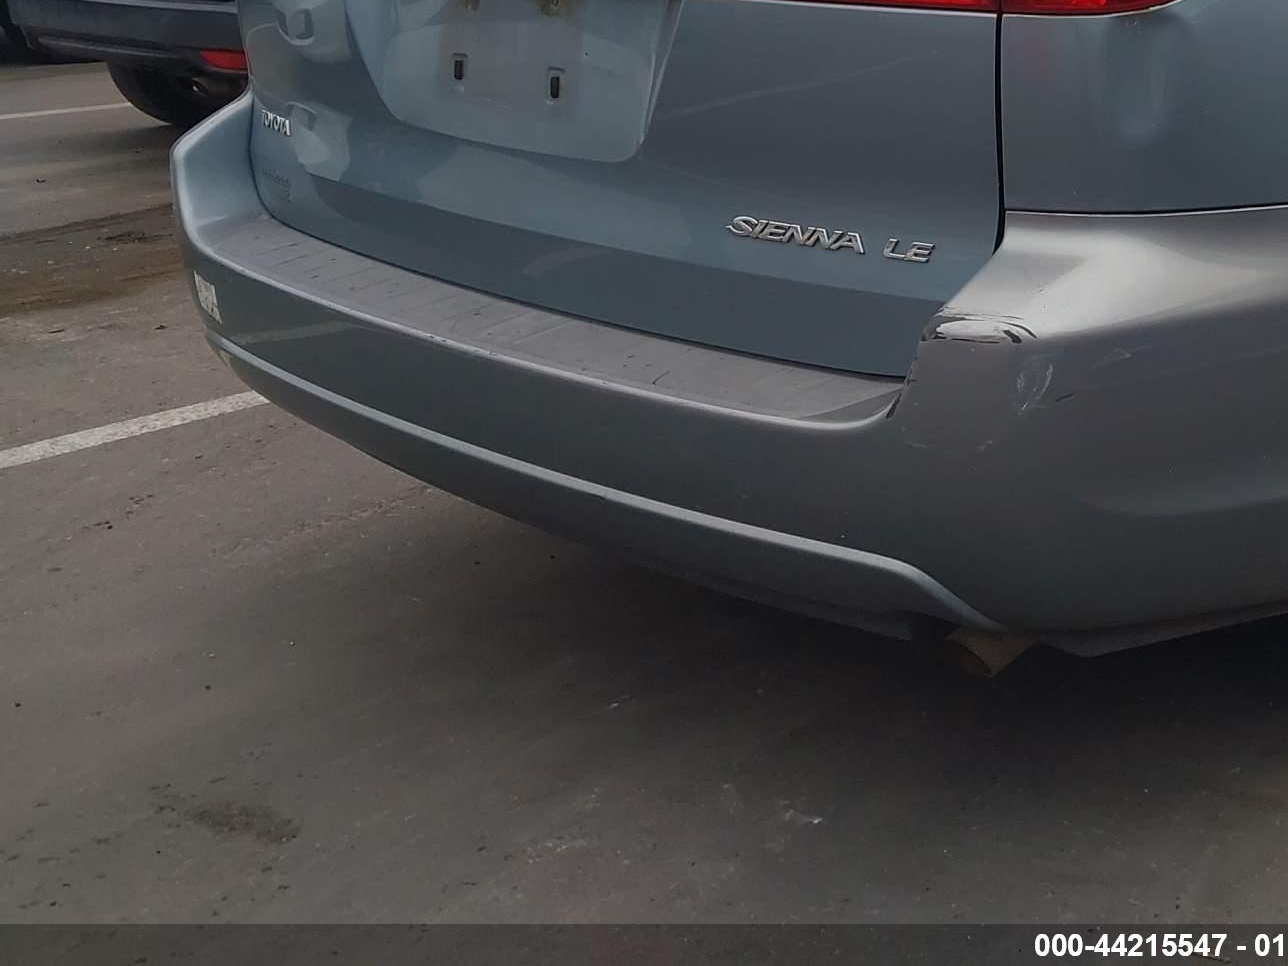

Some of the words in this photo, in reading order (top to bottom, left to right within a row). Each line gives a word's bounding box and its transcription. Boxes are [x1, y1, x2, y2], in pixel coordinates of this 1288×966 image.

[261, 109, 291, 136] TOYOTA
[726, 215, 865, 254] SIENNA
[883, 237, 936, 263] LE
